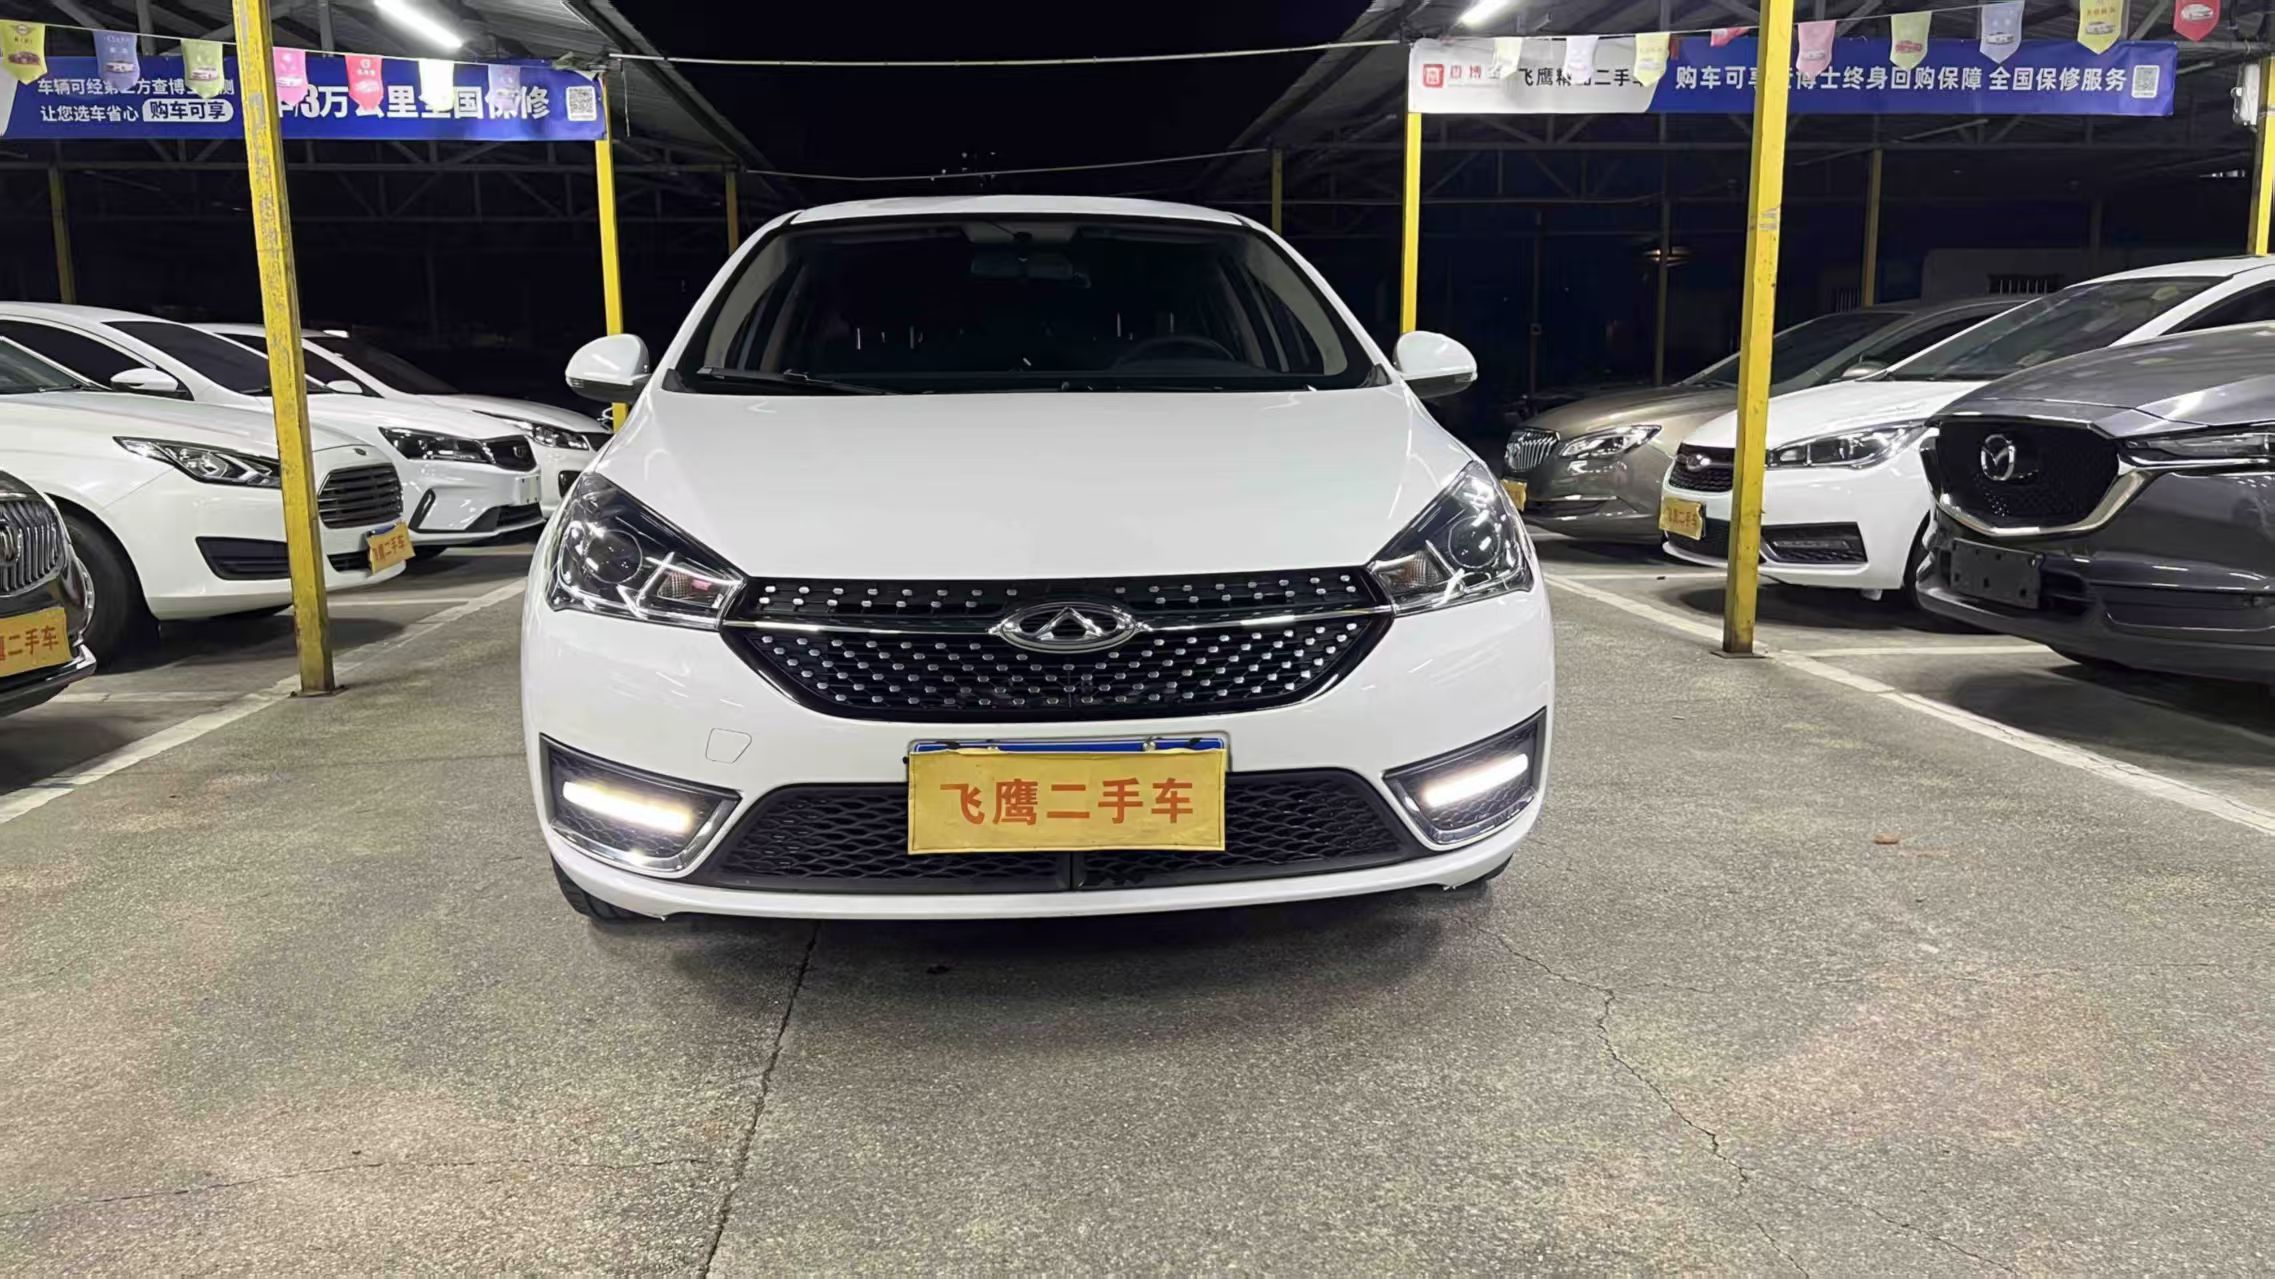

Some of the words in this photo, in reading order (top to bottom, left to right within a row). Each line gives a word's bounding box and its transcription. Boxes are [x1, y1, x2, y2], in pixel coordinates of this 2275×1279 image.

[37, 78, 234, 95] 车辆可经第方查博测
[1518, 67, 1643, 86] 飞鹰精二手
[1676, 65, 1982, 90] 购车可博士终身回购保障
[1989, 66, 2127, 91] 全国保修服务
[40, 106, 139, 122] 让您选车省心
[150, 101, 226, 119] 购车可享
[940, 777, 1194, 826] 飞鹰二手车
